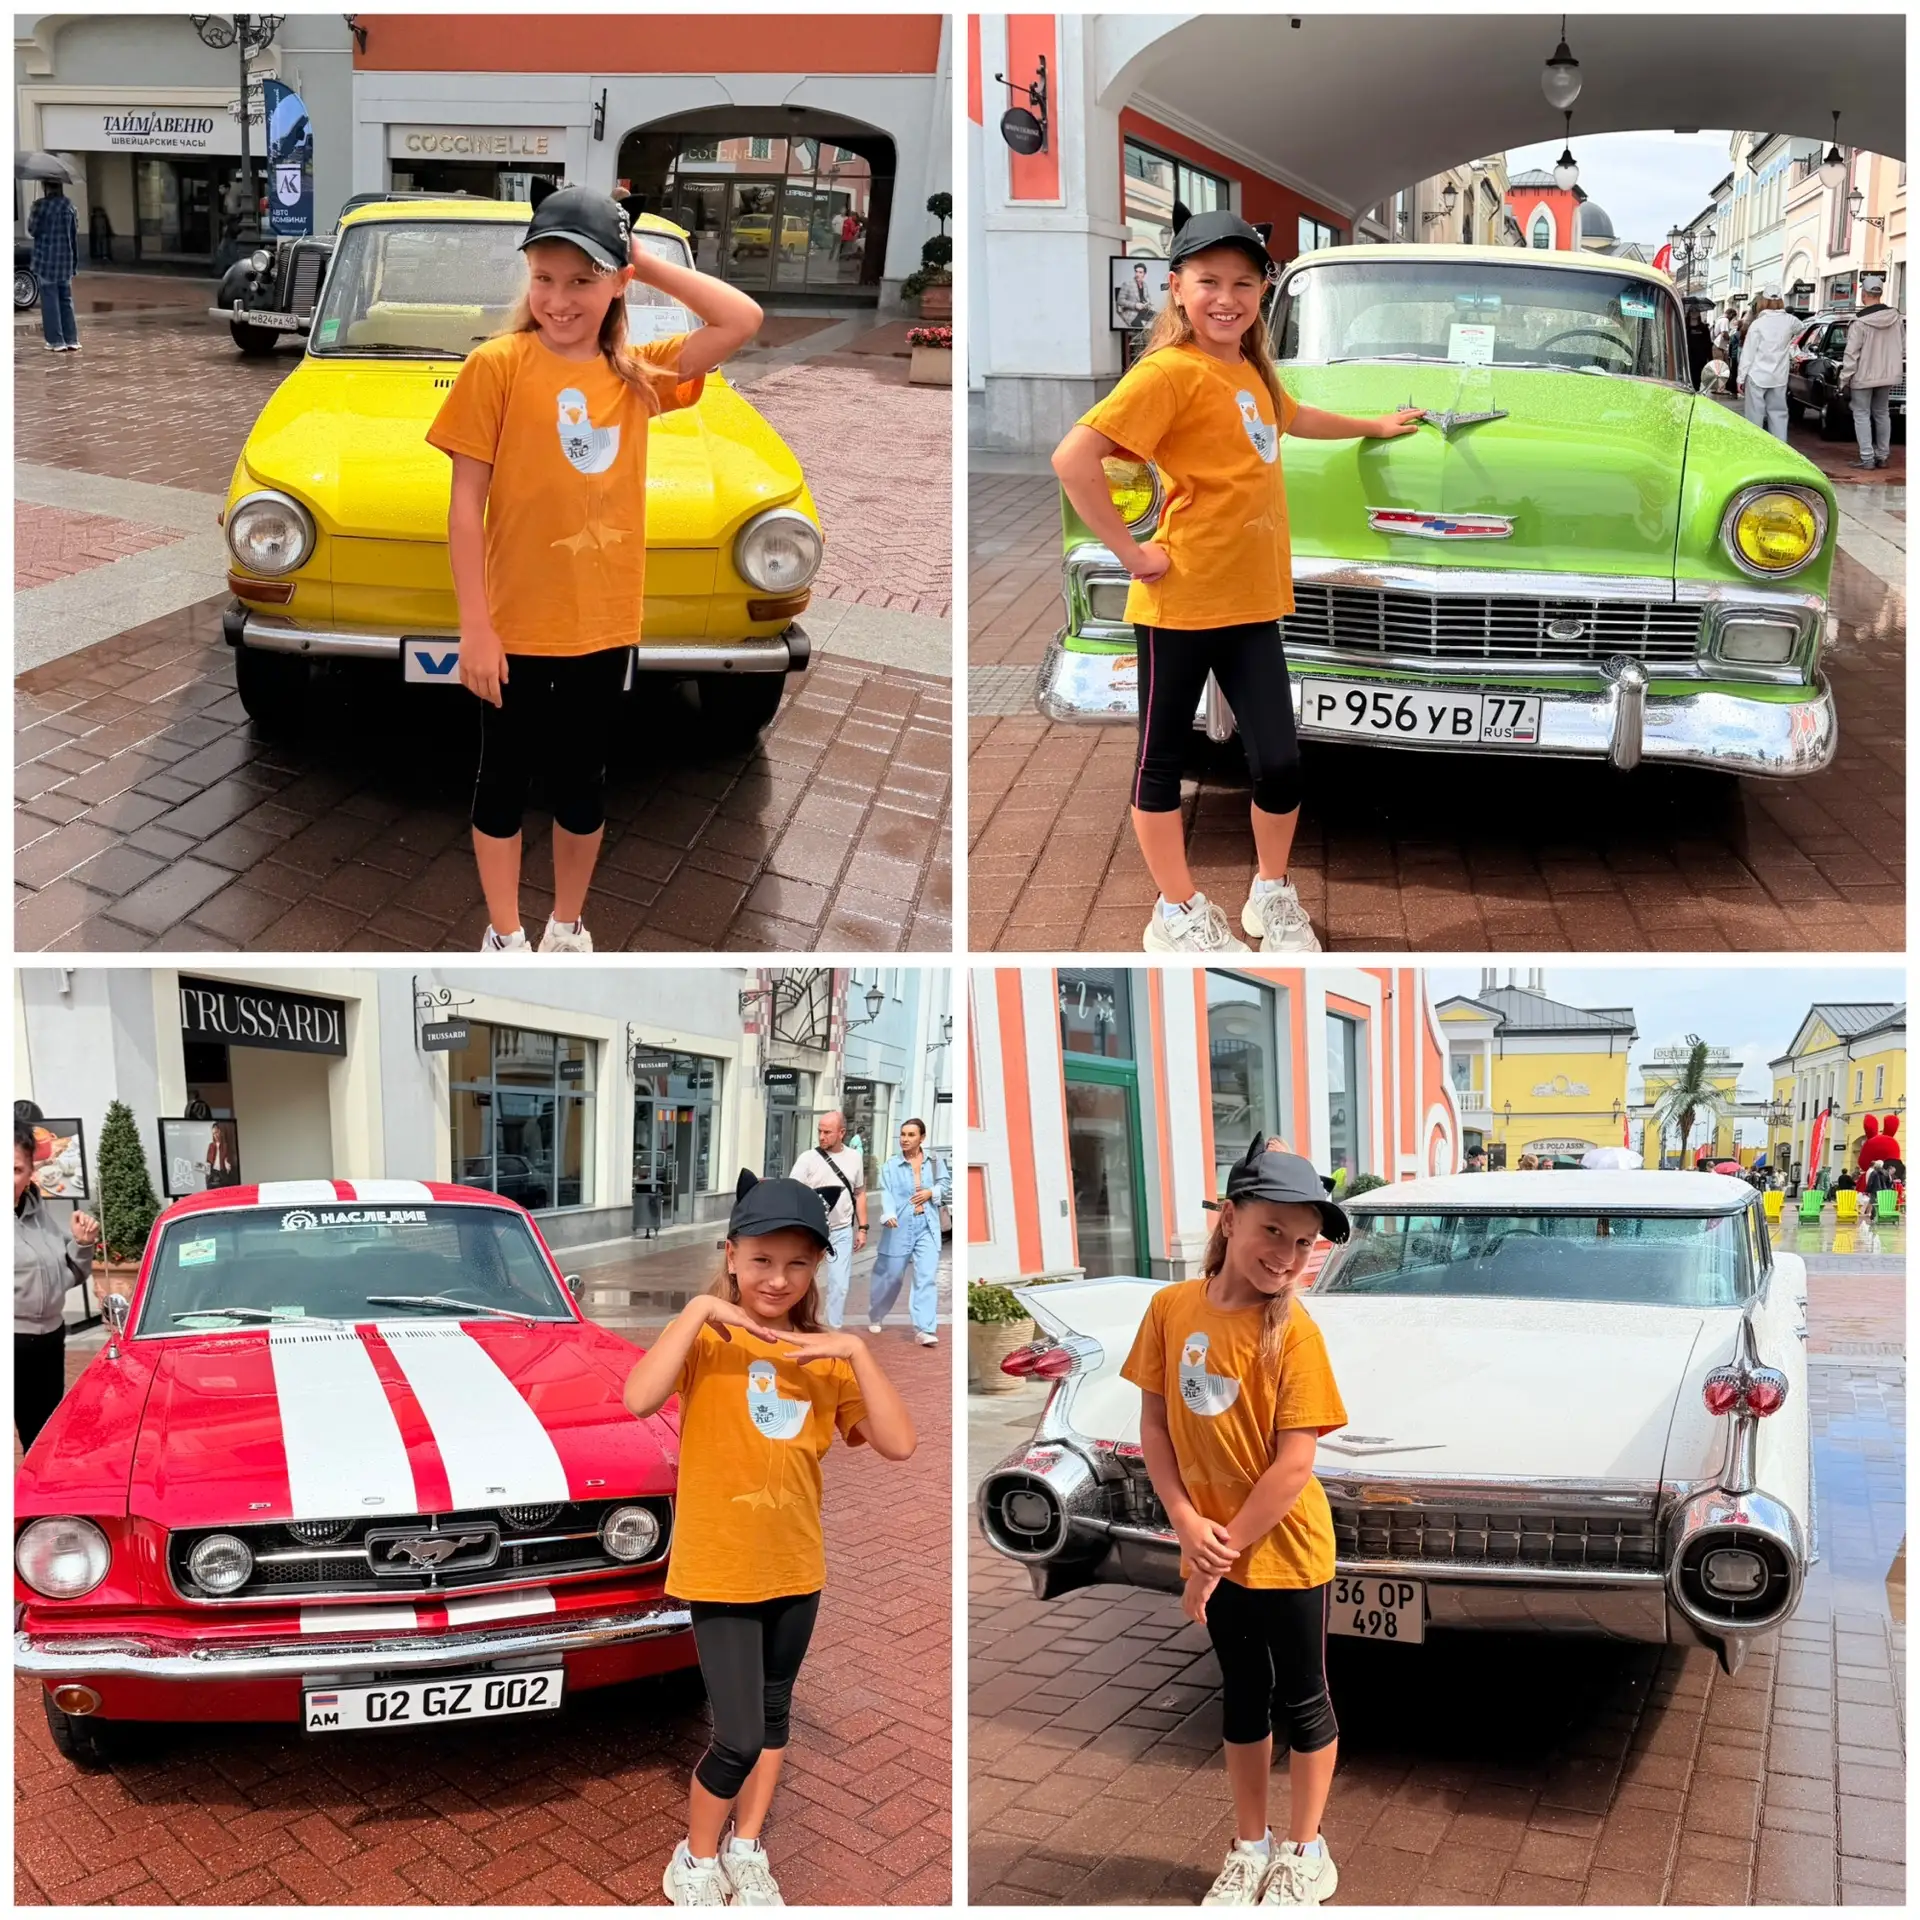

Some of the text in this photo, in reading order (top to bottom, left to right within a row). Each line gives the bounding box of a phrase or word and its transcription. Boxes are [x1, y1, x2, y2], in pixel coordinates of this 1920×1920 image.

[111, 137, 207, 147] ШВЕЙЦАРСКИЕ ЧАСЫ
[405, 133, 549, 155] COCCINELLE
[1488, 698, 1526, 728] 77
[1484, 728, 1512, 738] RUS
[179, 988, 340, 1045] TRUSSARDI
[427, 1030, 466, 1041] TRUSSARDI
[321, 1210, 428, 1225] НАСЛЕДИЕ
[1335, 1579, 1365, 1606] 36
[1352, 1608, 1398, 1638] 498
[366, 1676, 549, 1723] 02 GZ 002
[309, 1712, 339, 1727] AM
